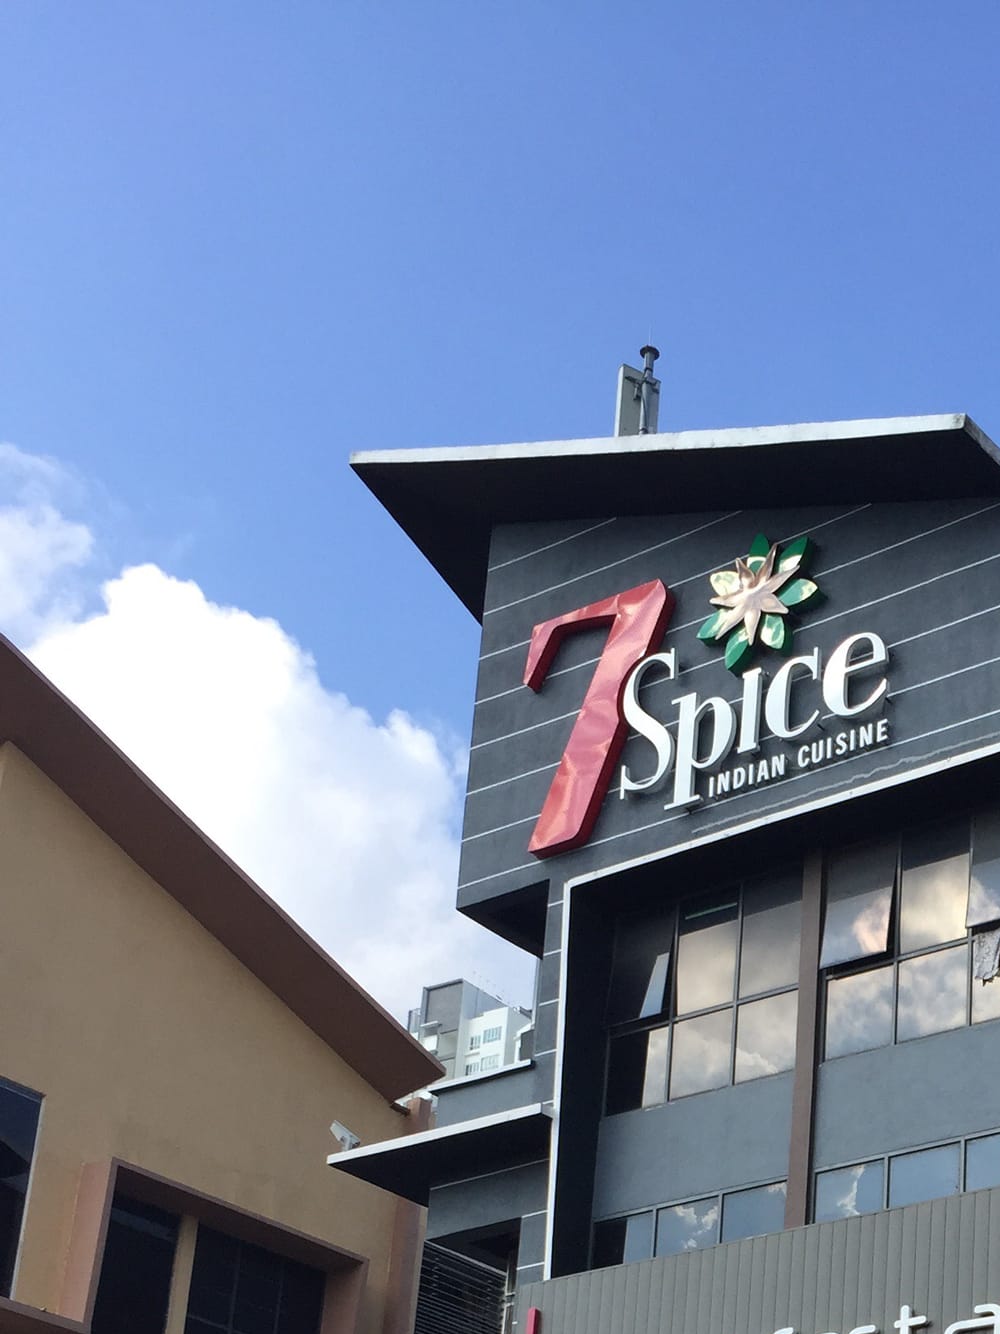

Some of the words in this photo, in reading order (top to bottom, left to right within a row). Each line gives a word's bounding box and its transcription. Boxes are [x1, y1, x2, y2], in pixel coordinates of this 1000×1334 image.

[521, 578, 674, 860] 7
[619, 631, 889, 812] Spice
[708, 753, 787, 798] INDIAN
[797, 718, 890, 768] CUISINE
